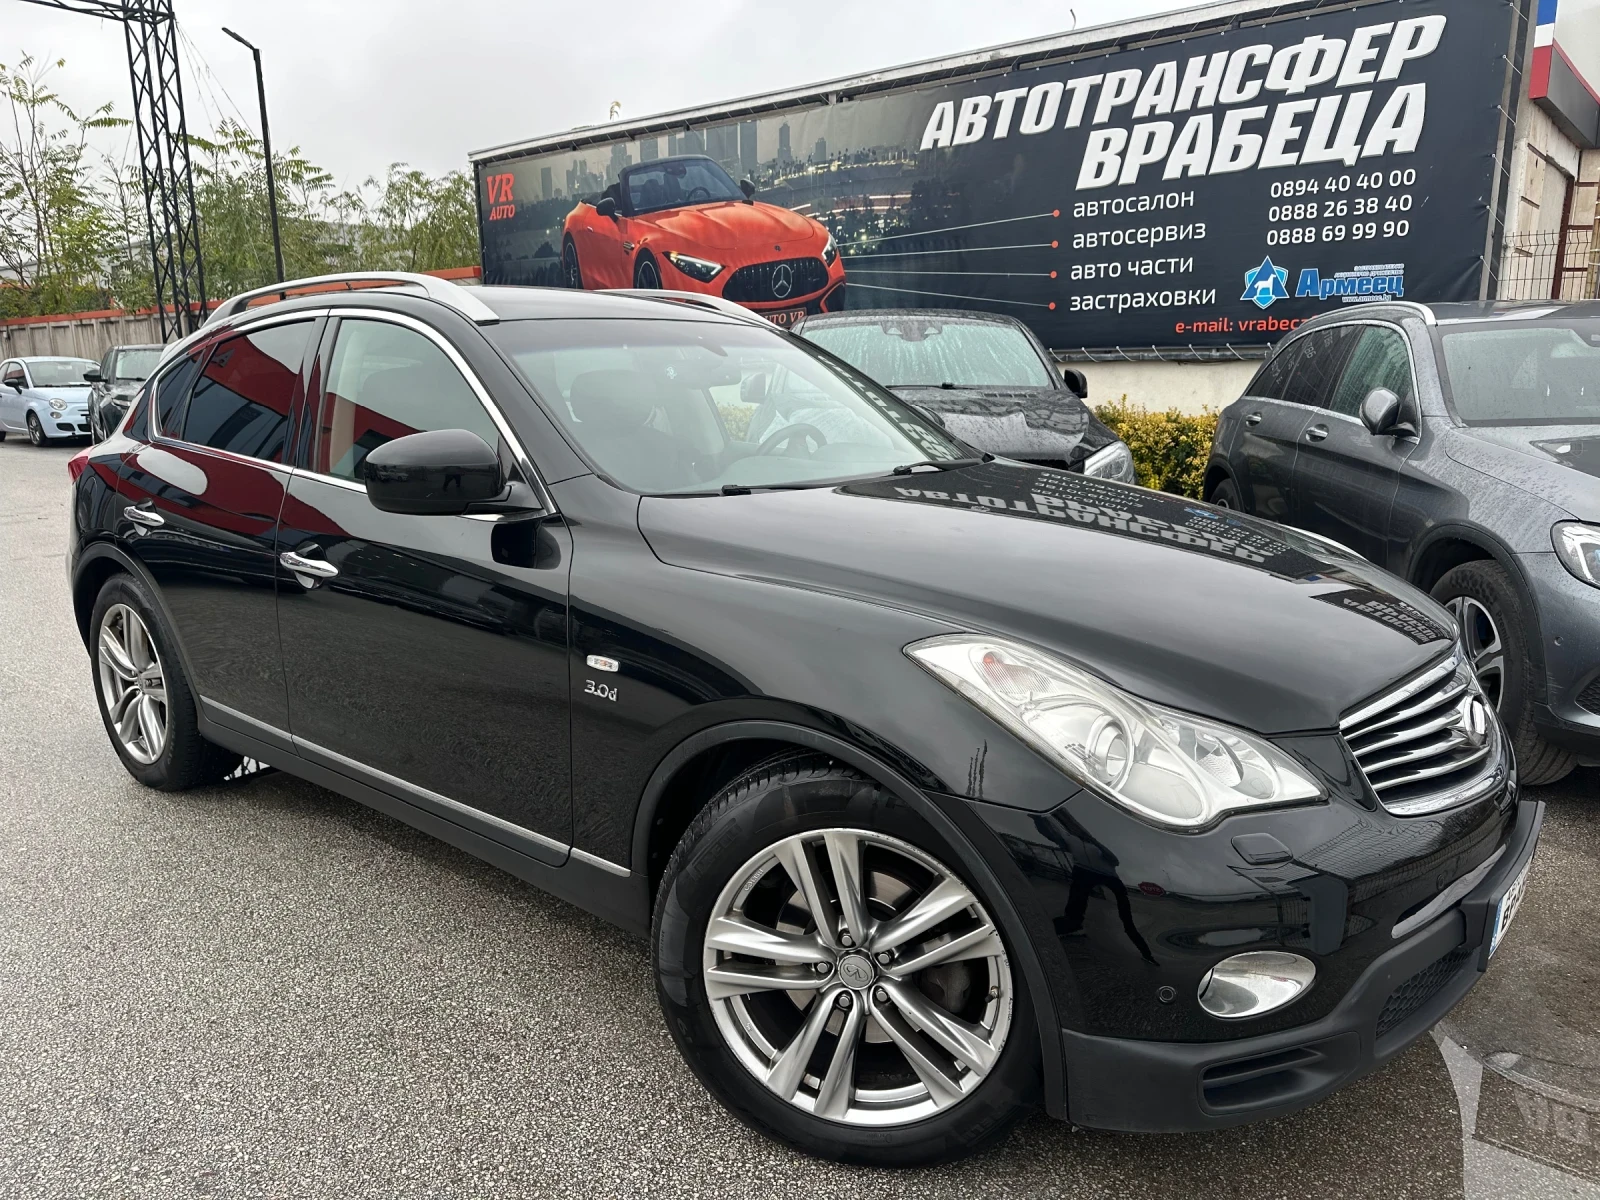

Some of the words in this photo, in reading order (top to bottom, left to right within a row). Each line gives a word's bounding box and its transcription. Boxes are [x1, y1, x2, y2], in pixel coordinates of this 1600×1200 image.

[919, 14, 1447, 151] АВТОТРАНСФЕР
[1075, 82, 1426, 191] ВРАБЕЦА
[486, 173, 515, 204] VR
[1270, 179, 1320, 198] 0894
[1324, 175, 1351, 193] 40
[1355, 171, 1383, 190] 40
[1388, 168, 1417, 187] 00
[489, 204, 515, 221] AUTO
[1073, 190, 1195, 218] автосалон
[1268, 203, 1318, 222] 0888
[1323, 200, 1348, 218] 26
[1352, 197, 1379, 215] 38
[1384, 194, 1413, 212] 40
[1072, 222, 1206, 248] автосервиз
[1266, 228, 1316, 246] 0888
[1321, 224, 1346, 242] 69
[1352, 222, 1377, 240] 99
[1382, 219, 1410, 238] 90
[1070, 263, 1121, 280] авто
[1127, 256, 1194, 277] части
[1295, 268, 1404, 300] Армеец
[1069, 288, 1216, 314] застраховки
[1175, 317, 1234, 333] e-mail:
[584, 679, 618, 702] 3.0d
